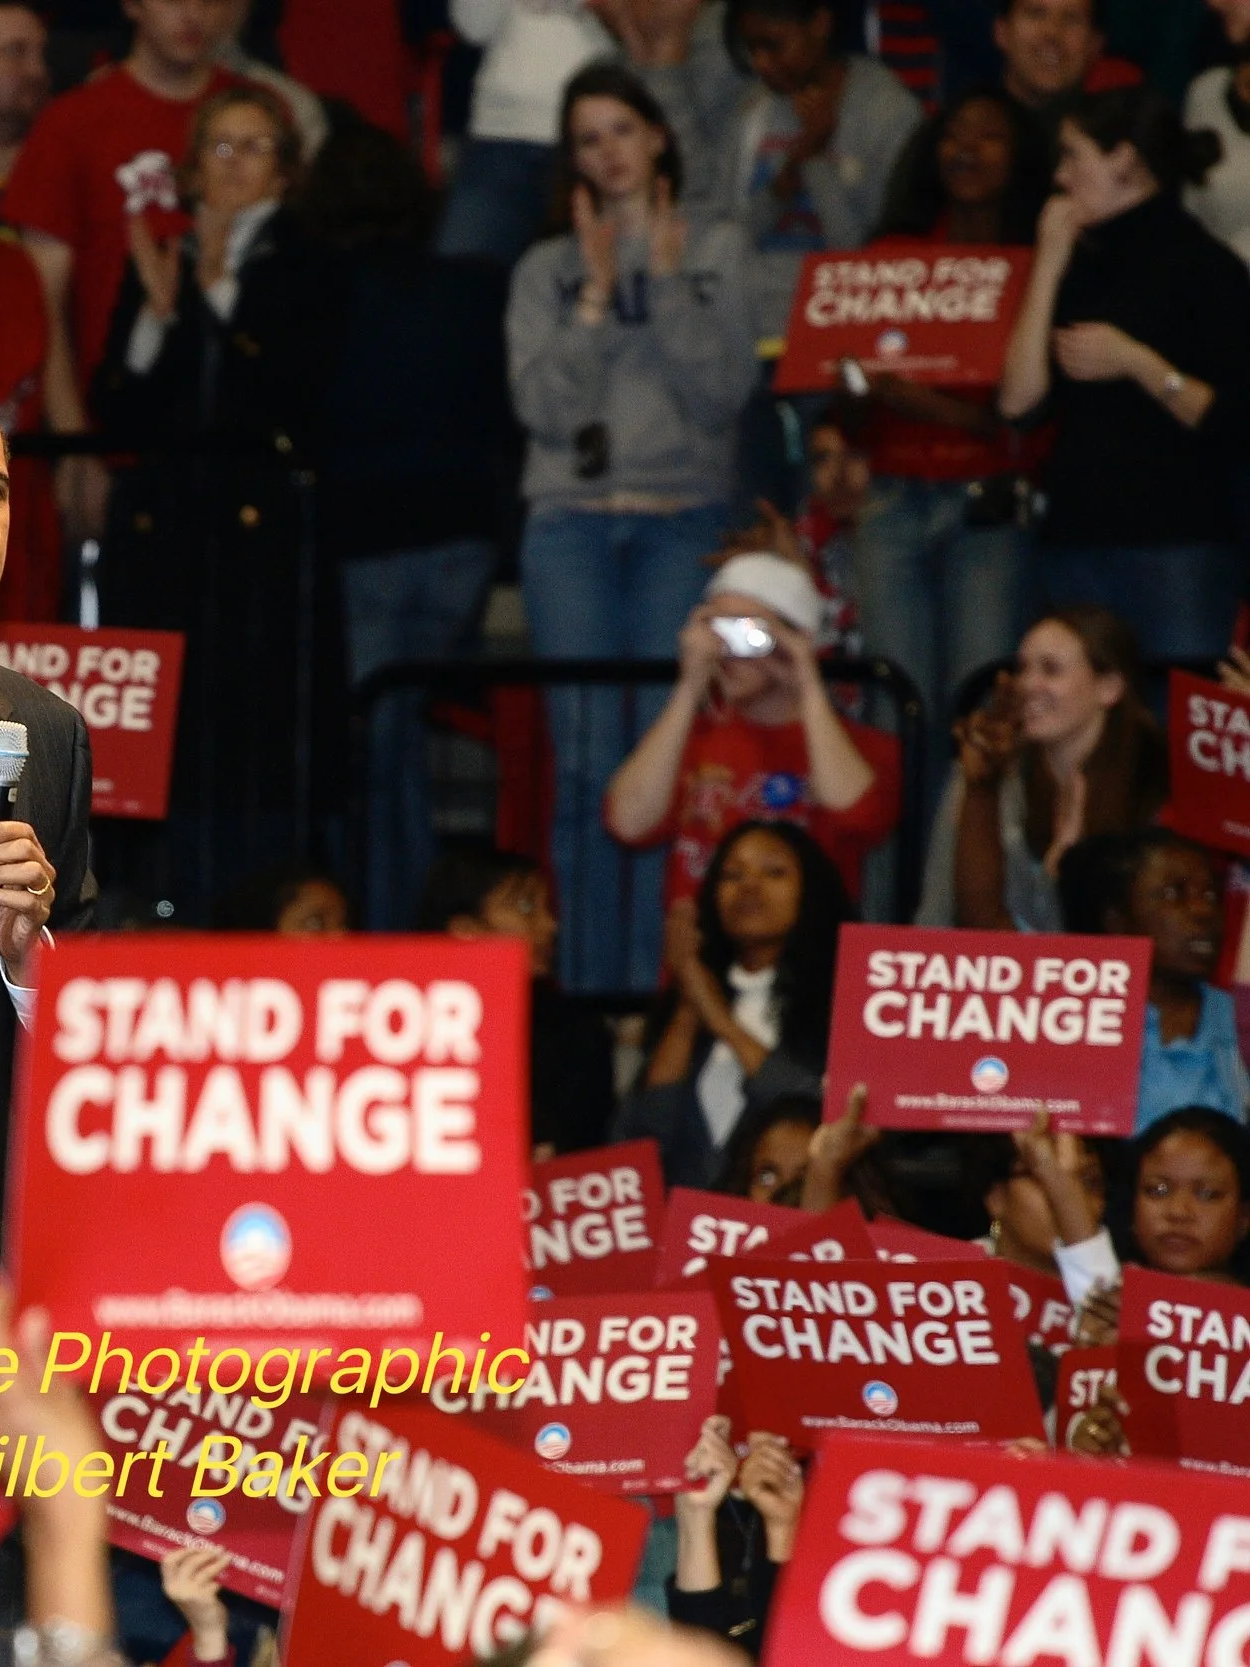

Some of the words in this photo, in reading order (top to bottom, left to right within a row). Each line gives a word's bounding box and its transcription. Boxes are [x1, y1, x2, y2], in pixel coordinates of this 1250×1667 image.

[814, 258, 929, 292] STAND
[933, 257, 1011, 288] FOR
[804, 286, 1000, 326] CHANGE
[75, 645, 161, 684] FOR
[48, 681, 155, 731] NGE
[866, 949, 1023, 993] STAND
[1032, 957, 1131, 997] FOR
[53, 976, 303, 1064] STAND
[316, 978, 483, 1065] FOR
[862, 989, 1126, 1046] CHANGE
[44, 1063, 482, 1176] CHANGE
[548, 1165, 643, 1216] FOR
[528, 1204, 653, 1270] NGE
[730, 1275, 878, 1317] STAND
[886, 1279, 988, 1318] FOR
[598, 1314, 698, 1353] FOR
[742, 1314, 1002, 1366] CHANGE
[101, 1394, 317, 1513] CHANG
[336, 1411, 479, 1540] STAND
[476, 1488, 602, 1601] FOR
[838, 1469, 1182, 1582] STAND
